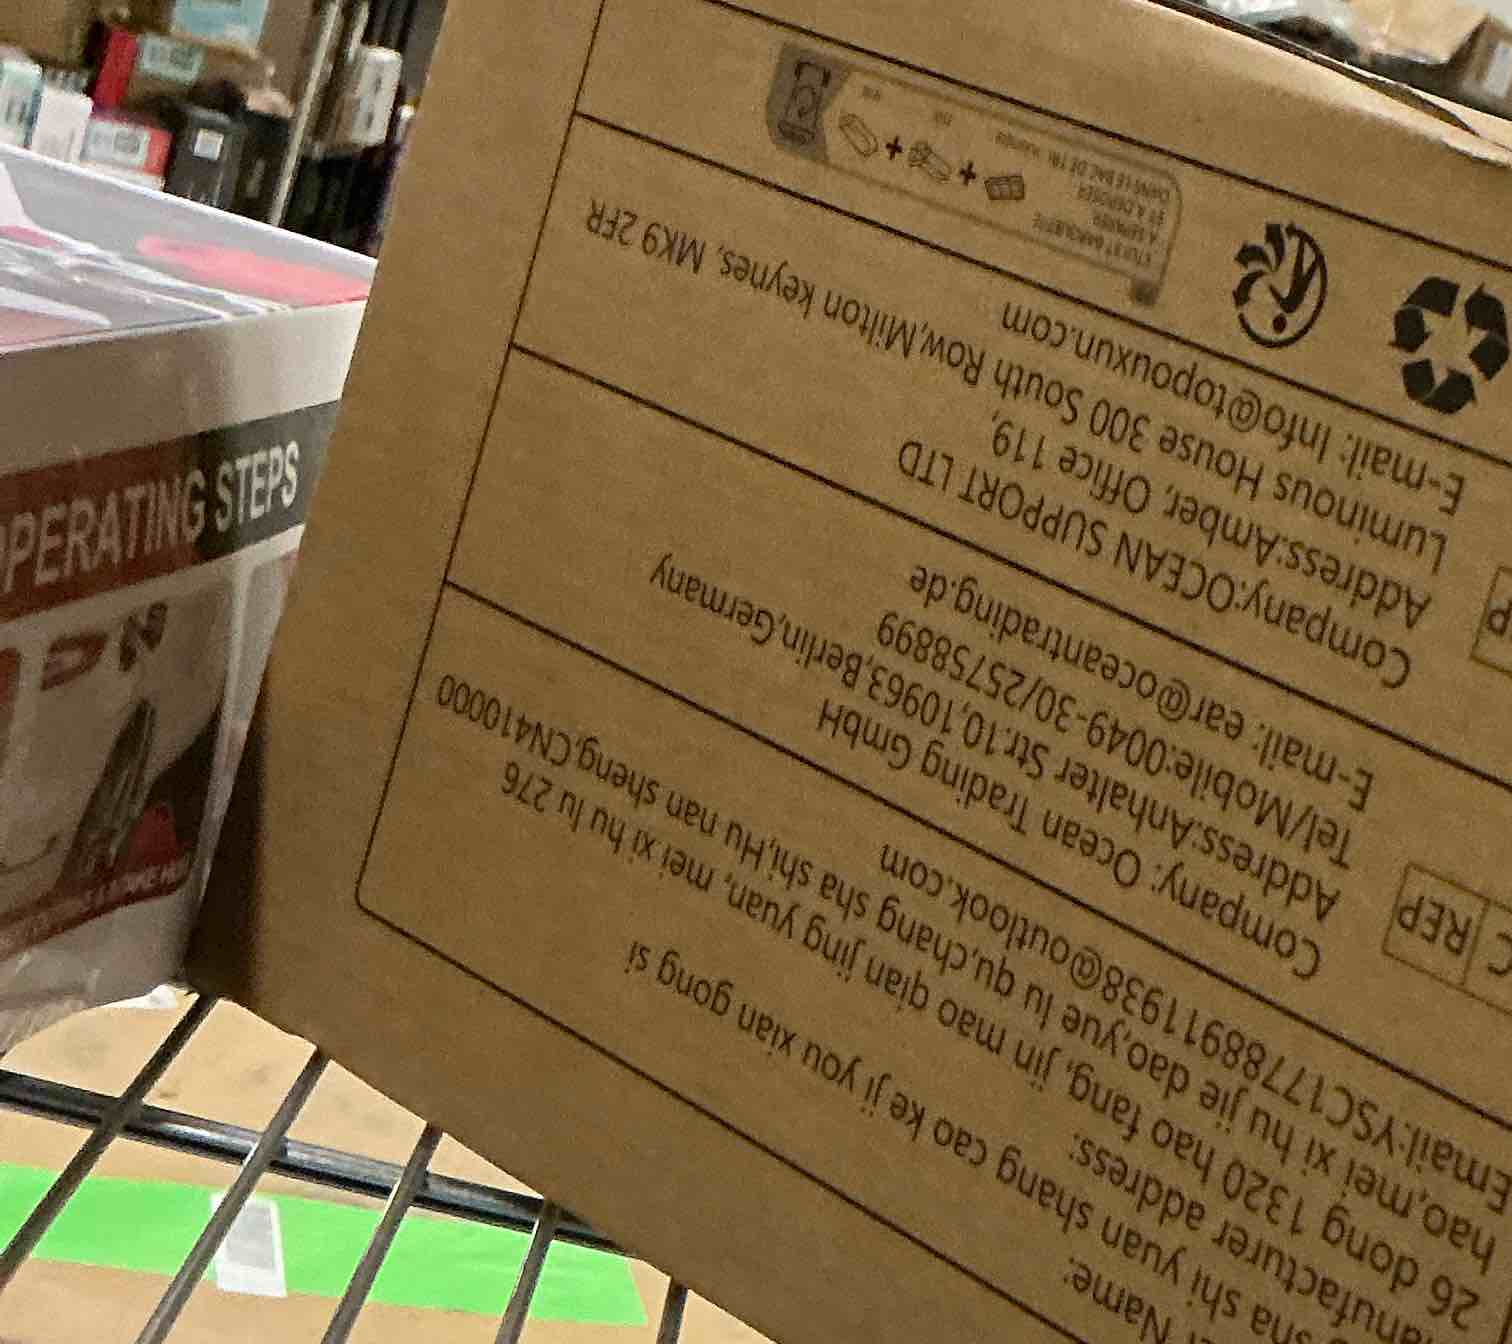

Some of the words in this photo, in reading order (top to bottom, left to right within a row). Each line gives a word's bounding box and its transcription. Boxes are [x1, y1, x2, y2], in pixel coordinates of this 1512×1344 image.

[585, 197, 638, 246] 2FR
[641, 221, 706, 274] MK9
[717, 243, 815, 320] keynes,
[823, 289, 985, 388] Row,Milton
[993, 358, 1084, 426] South
[1000, 301, 1331, 464] Info@topouxun.com
[991, 409, 1045, 471] 119,
[1088, 397, 1150, 454] 300
[897, 439, 954, 492] LTD
[1057, 445, 1151, 516] Office
[1157, 424, 1264, 501] House
[1339, 433, 1466, 517] E-mail:
[0, 470, 207, 594] PERATING
[215, 440, 300, 533] STEPS
[957, 464, 1108, 559] SUPPORT
[1272, 471, 1447, 576] Luminous
[1162, 483, 1432, 631] Address:Amber,
[1112, 530, 1411, 690] Company:OCEAN
[908, 564, 1244, 741] ear@oceantrading.de
[815, 698, 911, 770] GmbH
[1251, 722, 1374, 813] E-mail:
[501, 760, 553, 813] 276
[557, 789, 584, 833] lu
[919, 738, 1028, 836] Trading
[589, 806, 625, 854] hu
[628, 828, 656, 863] xi
[1041, 808, 1141, 889] Ocean
[658, 844, 714, 892] mei
[727, 880, 801, 939] yuan,
[1150, 860, 1321, 981] Company:
[1395, 888, 1471, 956] REP
[623, 940, 650, 974] si
[801, 912, 867, 983] jing
[655, 948, 734, 1016] gong
[864, 956, 929, 1012] qian
[737, 1003, 797, 1056] xian
[937, 997, 1006, 1055] mao
[801, 1040, 862, 1092] you
[859, 1072, 892, 1117] ji
[1013, 1039, 1062, 1092] jin
[889, 1091, 925, 1143] ke
[1067, 1061, 1141, 1143] fang,
[933, 1117, 987, 1168] cao
[1151, 1117, 1215, 1186] hao
[995, 1144, 1093, 1234] shang
[1068, 1132, 1205, 1231] address:
[1222, 1156, 1304, 1236] 1320
[1100, 1215, 1187, 1285] yuan
[1320, 1202, 1419, 1294] dong
[1185, 1265, 1241, 1323] shi
[1426, 1273, 1480, 1332] 26
